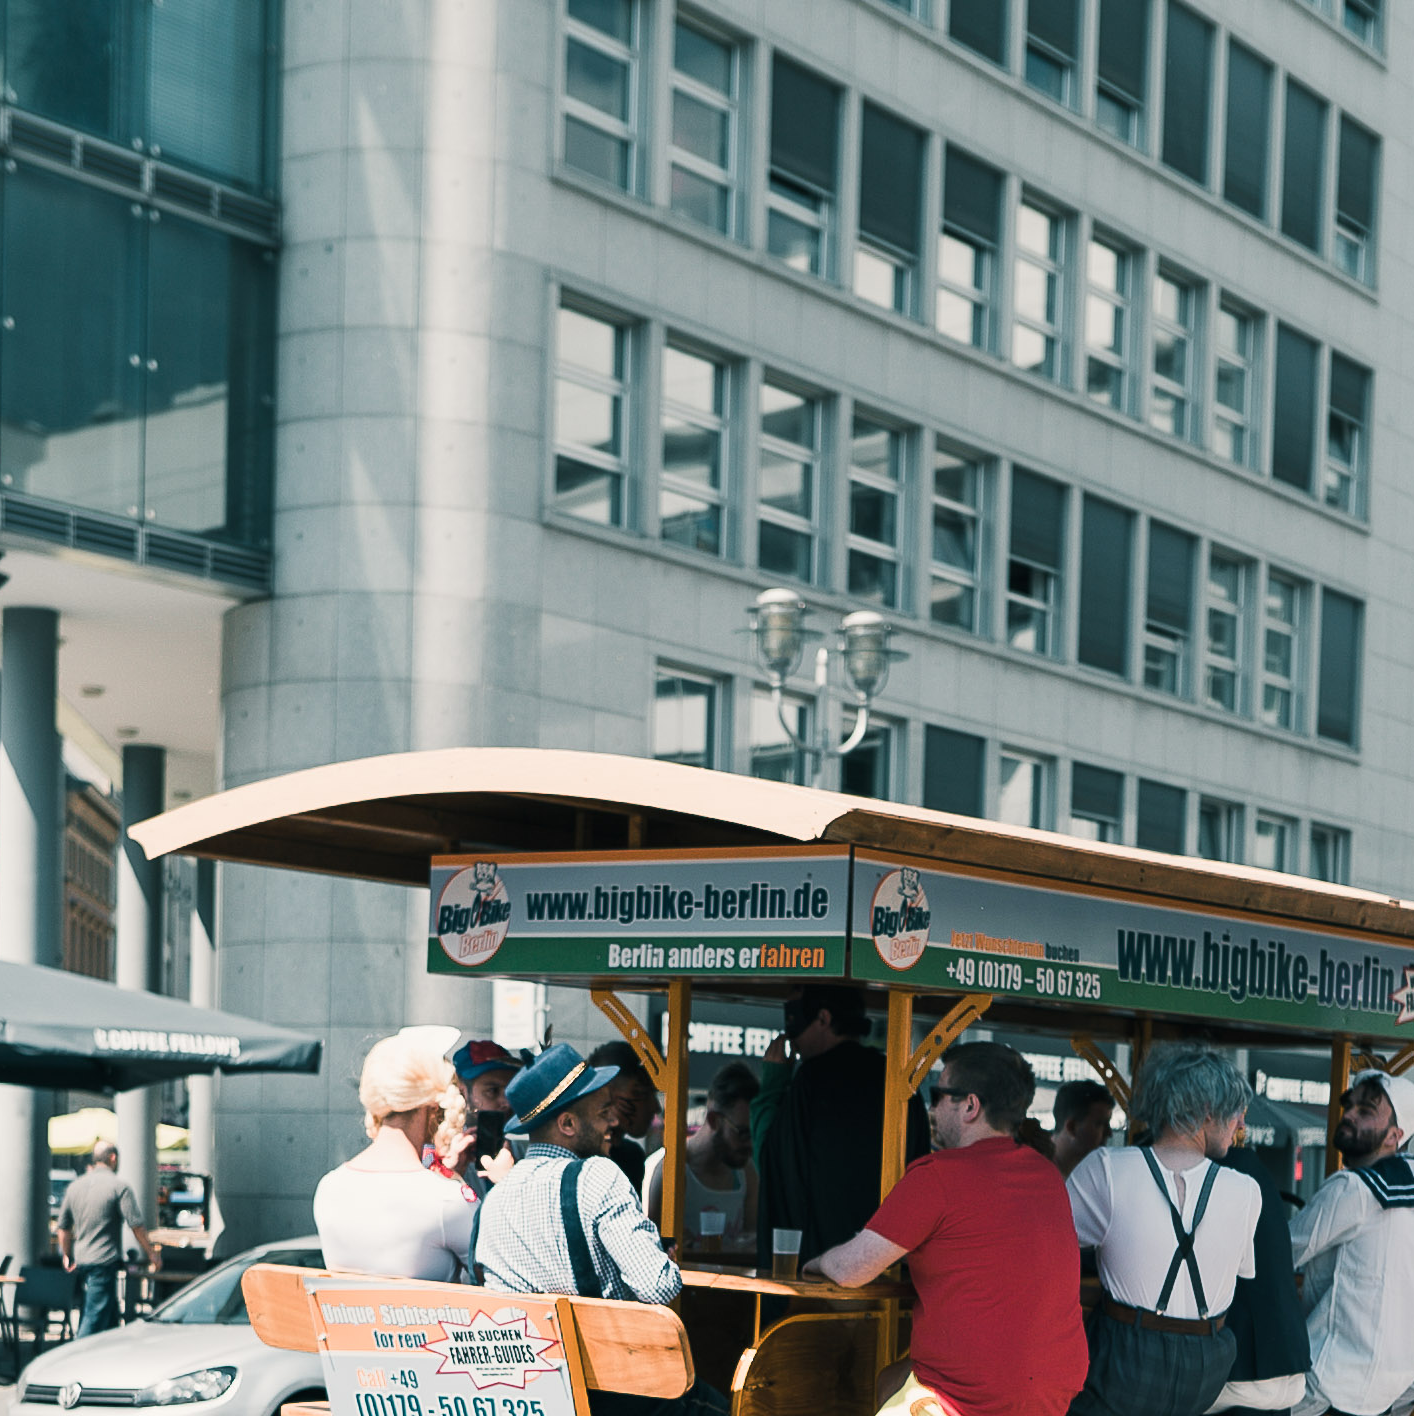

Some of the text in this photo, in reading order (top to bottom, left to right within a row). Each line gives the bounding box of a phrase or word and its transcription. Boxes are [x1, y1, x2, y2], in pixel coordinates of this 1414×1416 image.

[526, 881, 829, 925] www.bigbike-berlin.de
[438, 899, 512, 936] Big Bike
[872, 904, 931, 938] Big Bike
[459, 929, 499, 958] Berlin
[608, 943, 825, 969] Berlin anders erfahren
[889, 934, 921, 962] Berlin
[1044, 942, 1080, 963] buchen
[946, 957, 975, 986] +49
[978, 961, 1022, 991] (0)179
[1036, 967, 1055, 994] 50
[1057, 969, 1073, 996] 67
[1075, 971, 1101, 999] 325
[1116, 928, 1408, 1015] www.bigbike-berlin.
[321, 1303, 376, 1326] Unique
[373, 1329, 428, 1349] for rent
[451, 1328, 523, 1343] WIR SUCHEN
[449, 1344, 536, 1366] FAHRER-GUIDES
[356, 1367, 420, 1390] Call +49
